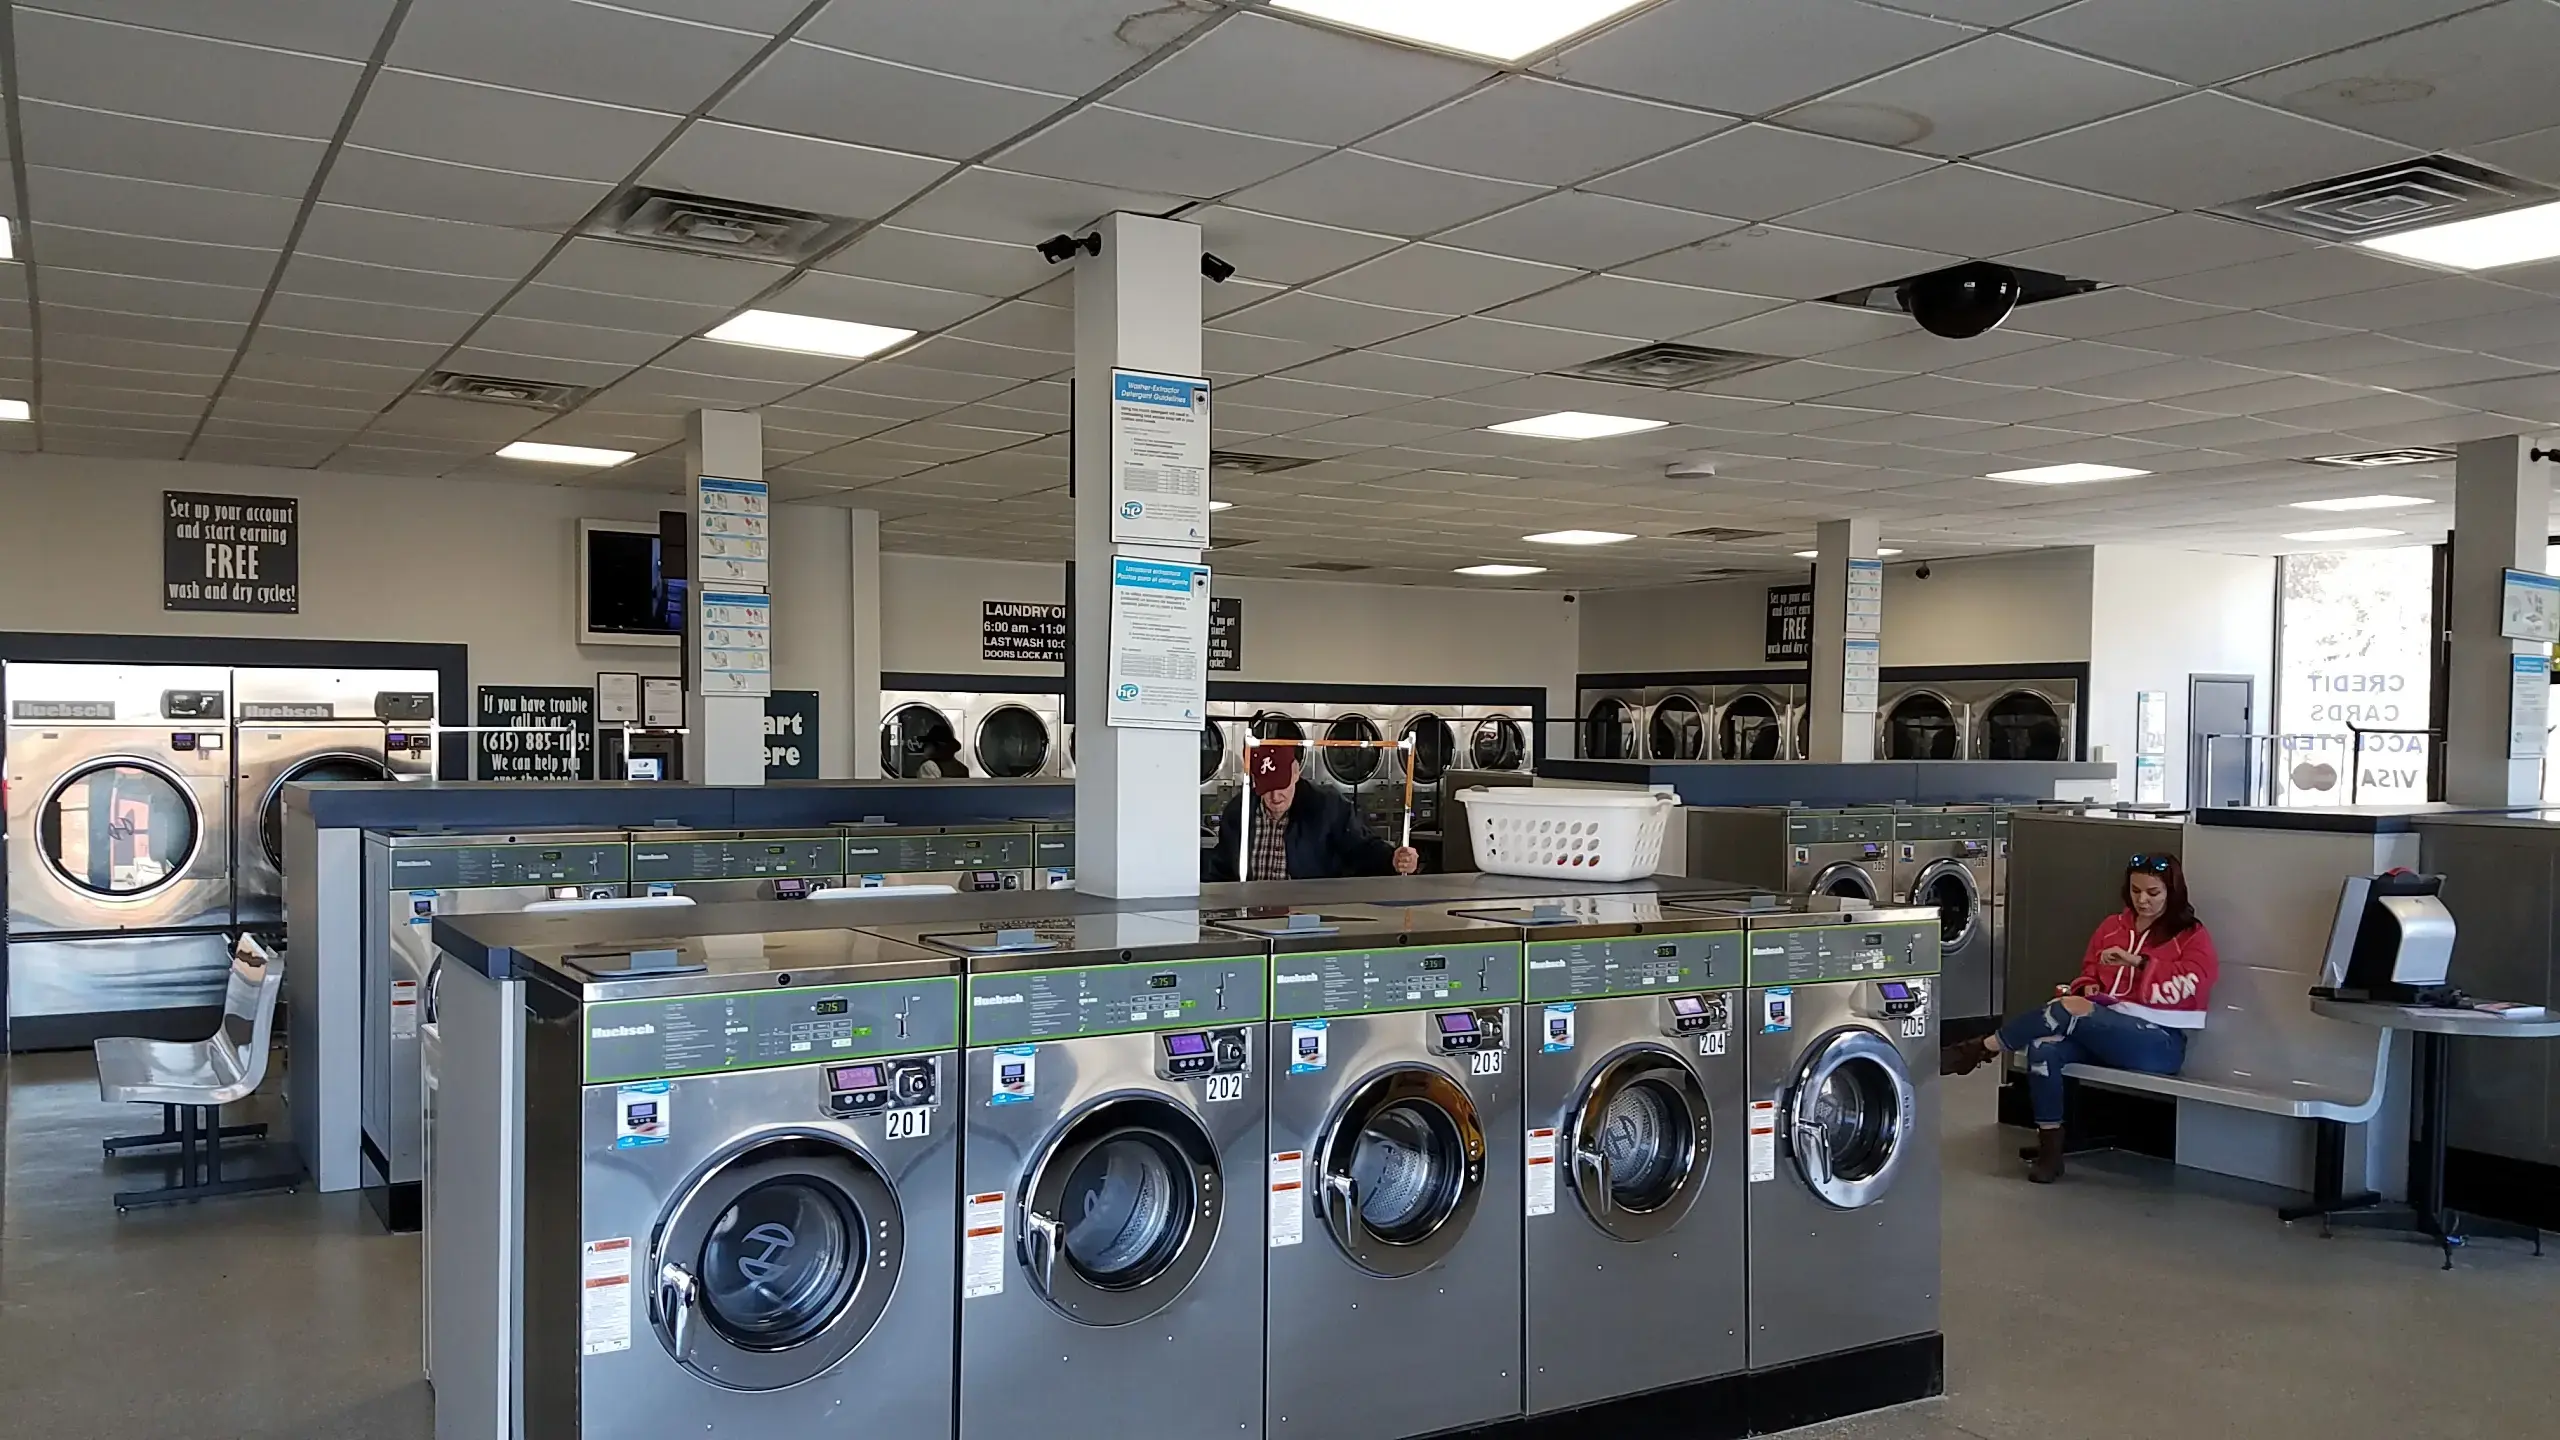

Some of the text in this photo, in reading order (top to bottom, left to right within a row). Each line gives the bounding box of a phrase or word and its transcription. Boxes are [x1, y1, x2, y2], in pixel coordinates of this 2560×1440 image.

[1121, 389, 1187, 404] Detergent Guidelines
[1128, 381, 1180, 394] Washer-Extractor
[170, 499, 293, 523] Set up your account
[177, 521, 287, 545] and start earning
[205, 543, 259, 580] FREE
[169, 581, 296, 603] wash and dry cycles!
[985, 603, 1049, 618] LAUNDRY
[984, 620, 1008, 632] 6:00
[1011, 624, 1029, 634] am
[1782, 616, 1807, 640] FREE
[984, 636, 1012, 646] LAST
[1012, 637, 1044, 648] WASH
[984, 650, 1016, 658] DOORS
[1016, 650, 1040, 659] LOCK
[1042, 652, 1053, 660] AT
[18, 702, 110, 717] Huebsch
[244, 705, 329, 718] Huebsch
[484, 694, 588, 714] If you have trouble
[764, 712, 803, 735] art
[482, 732, 590, 752] (615) 885-115!
[492, 754, 508, 771] We
[512, 757, 531, 771] can
[534, 754, 558, 772] help
[764, 746, 800, 766] ere
[592, 1023, 655, 1039] Huebsch
[1903, 1018, 1924, 1036] 205
[1701, 1034, 1724, 1054] 204
[1474, 1052, 1501, 1074] 203
[1208, 1076, 1241, 1100] 202
[888, 1110, 927, 1140] 201
